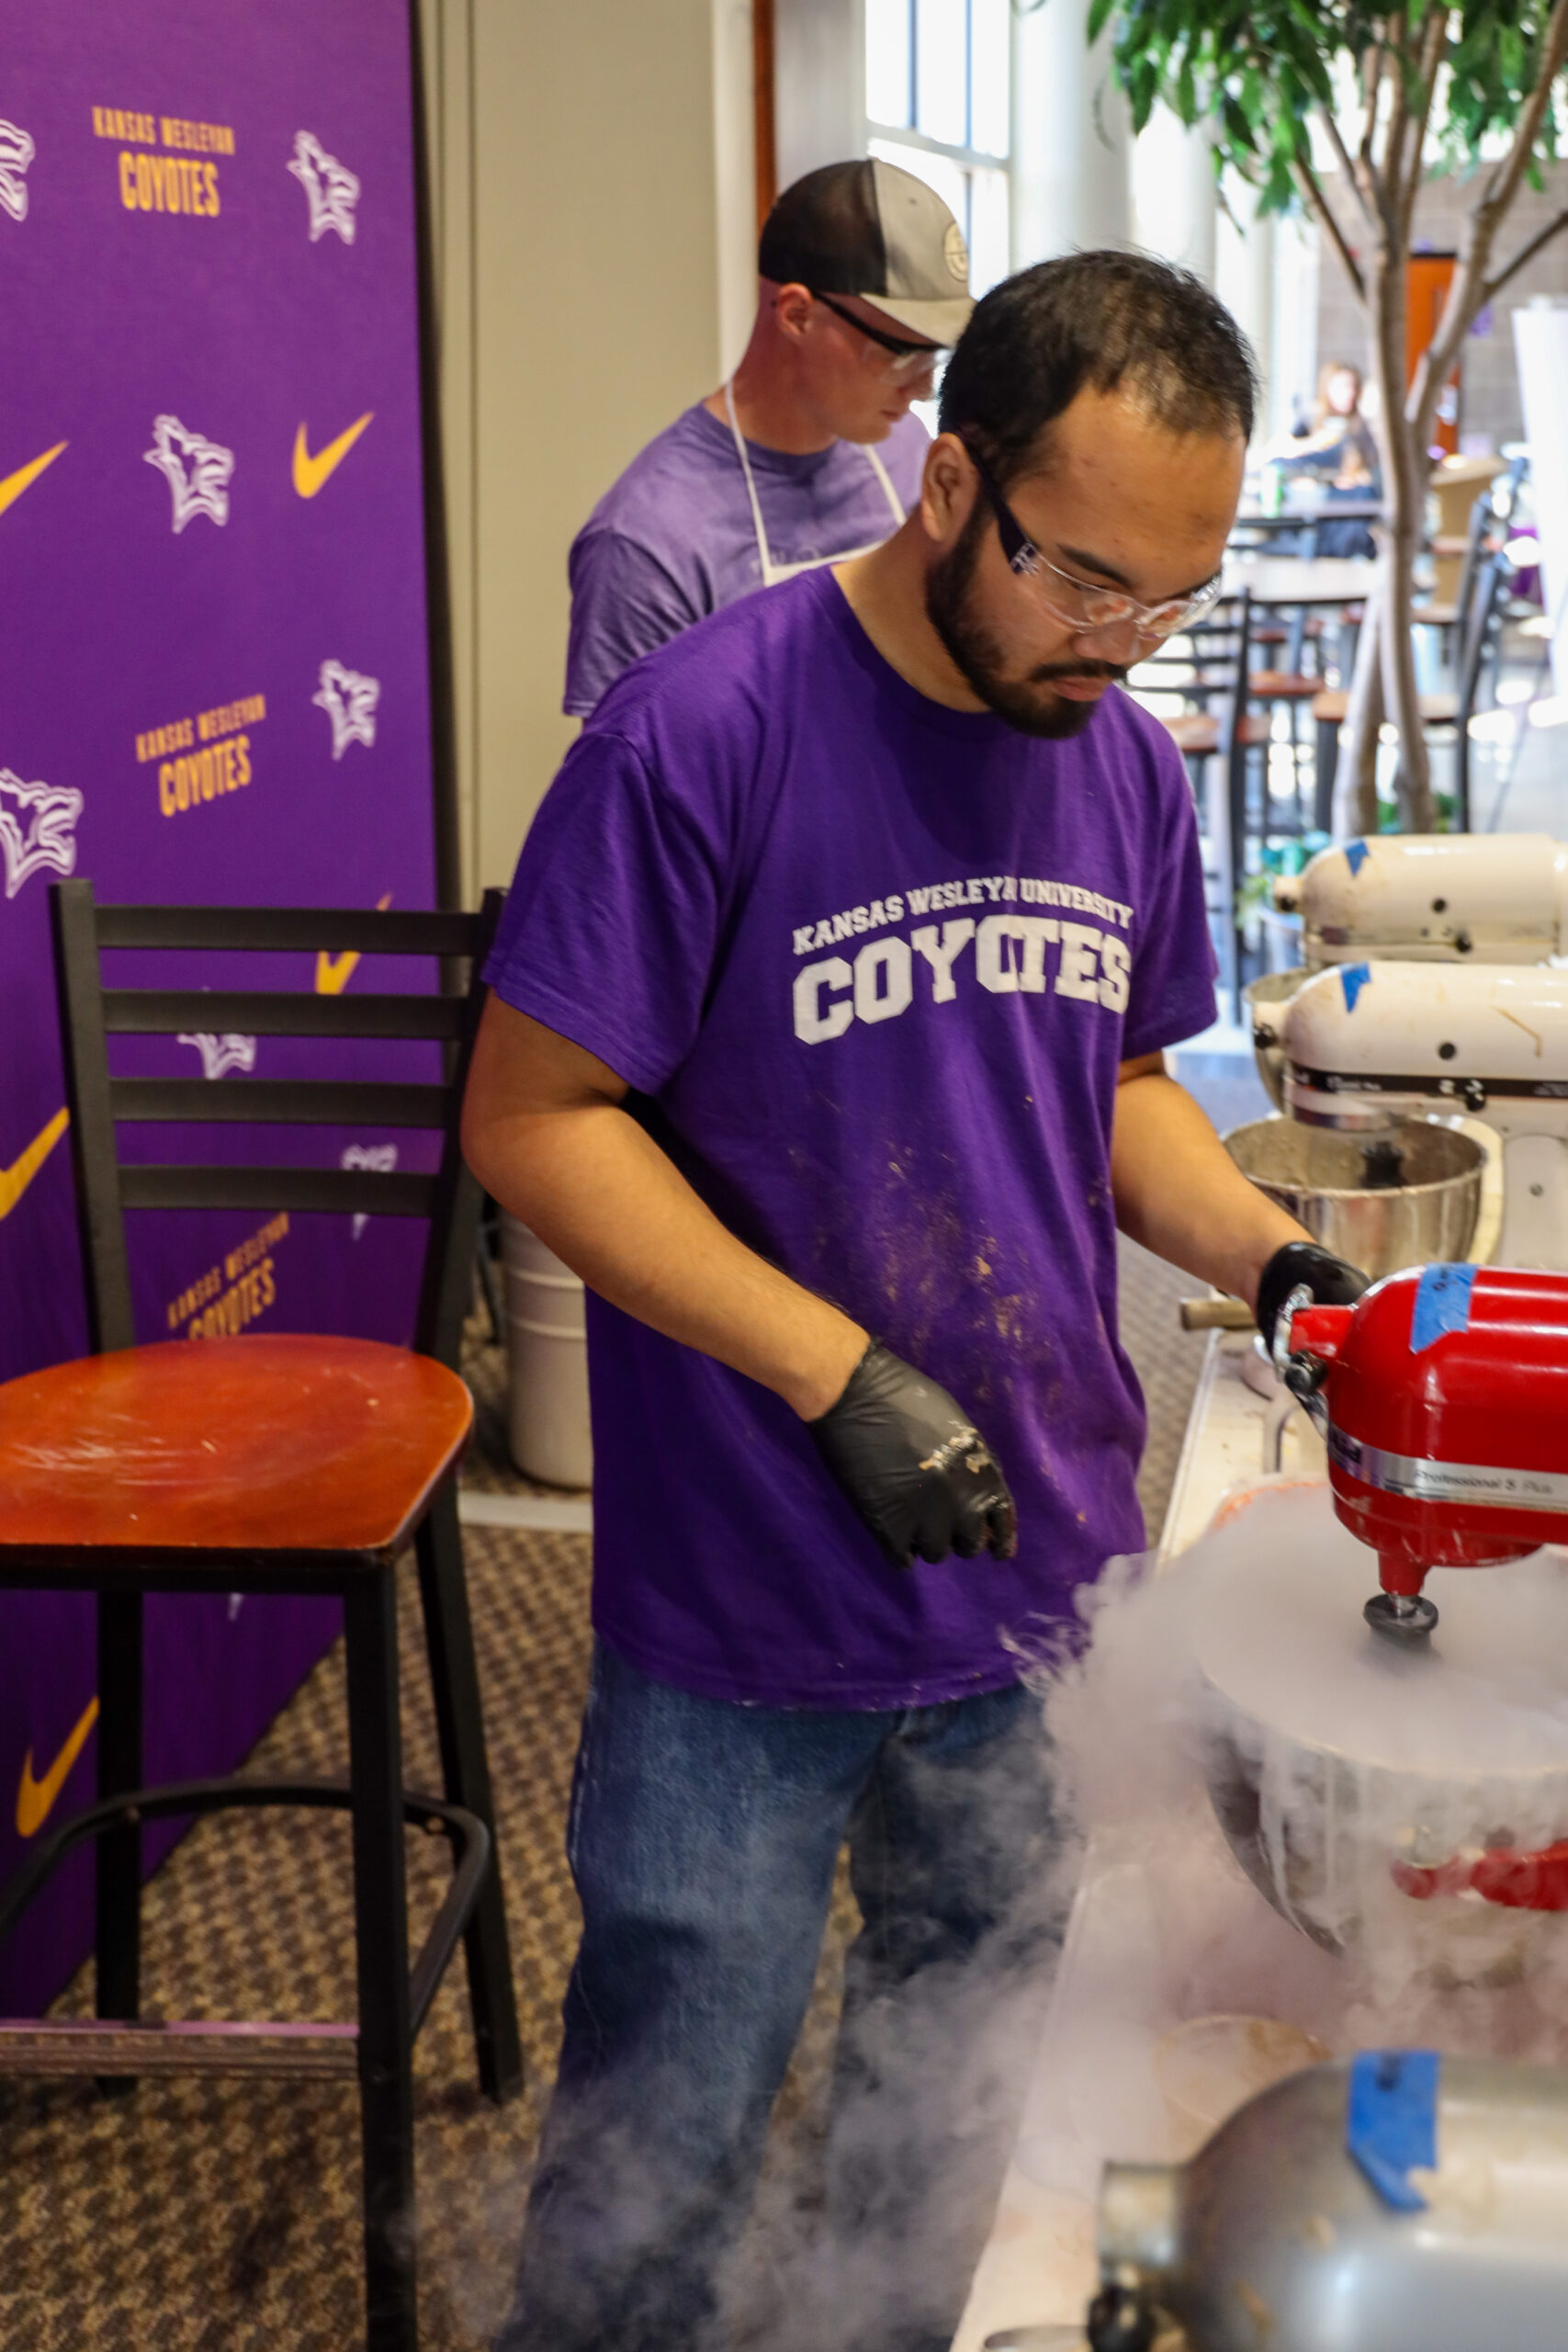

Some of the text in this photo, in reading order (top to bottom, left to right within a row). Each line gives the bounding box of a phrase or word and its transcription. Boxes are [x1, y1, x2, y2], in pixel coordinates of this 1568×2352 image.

[93, 106, 235, 156] KANSAS WESLEYAN
[119, 151, 220, 218] COYOTES
[136, 693, 266, 763] KANSAS WESLEYAN
[160, 734, 252, 817] COYOTES
[793, 895, 905, 956] KANSAS
[793, 913, 1132, 1046] COYOTES
